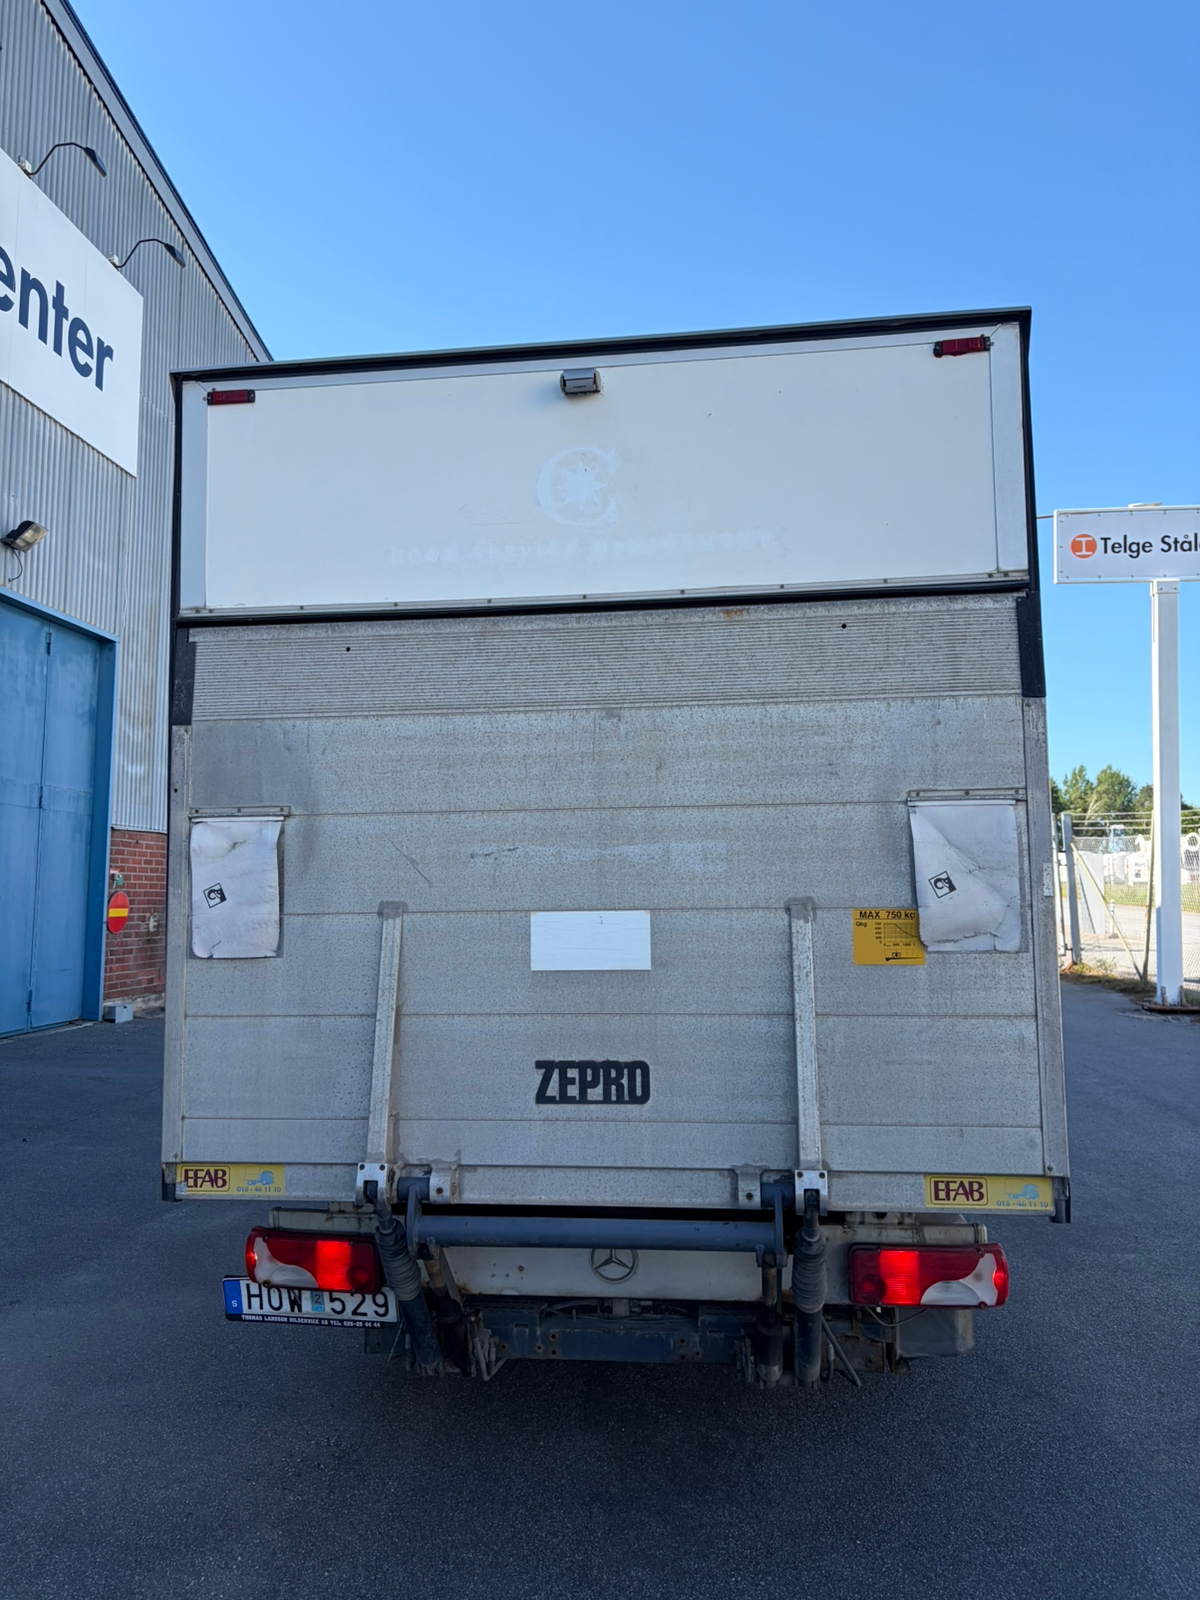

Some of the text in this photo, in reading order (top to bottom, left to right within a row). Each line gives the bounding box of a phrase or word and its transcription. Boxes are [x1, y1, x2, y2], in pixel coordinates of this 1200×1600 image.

[1100, 532, 1200, 559] Telge Stål
[859, 911, 916, 920] MAX 750 kg
[535, 1060, 650, 1105] ZEPRO
[184, 1168, 227, 1189] EFAB
[933, 1180, 985, 1202] EFAB
[231, 1299, 238, 1308] S
[245, 1283, 389, 1318] HOW 529
